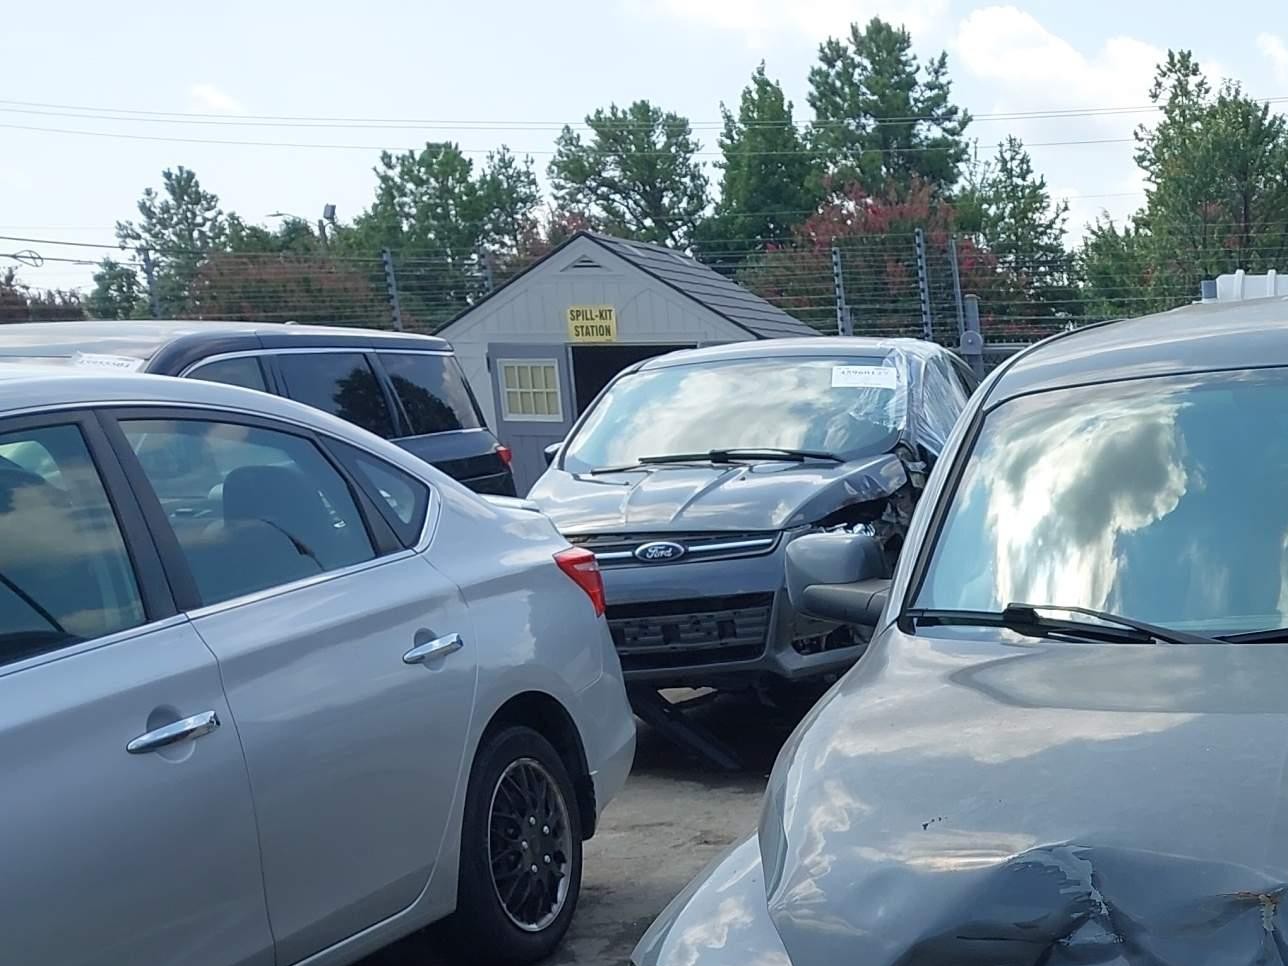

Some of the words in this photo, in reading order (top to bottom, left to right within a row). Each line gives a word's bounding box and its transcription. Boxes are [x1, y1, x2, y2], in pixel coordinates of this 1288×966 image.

[569, 309, 612, 321] SPILL-KIT
[574, 324, 612, 337] STATION
[646, 546, 672, 558] Ford
